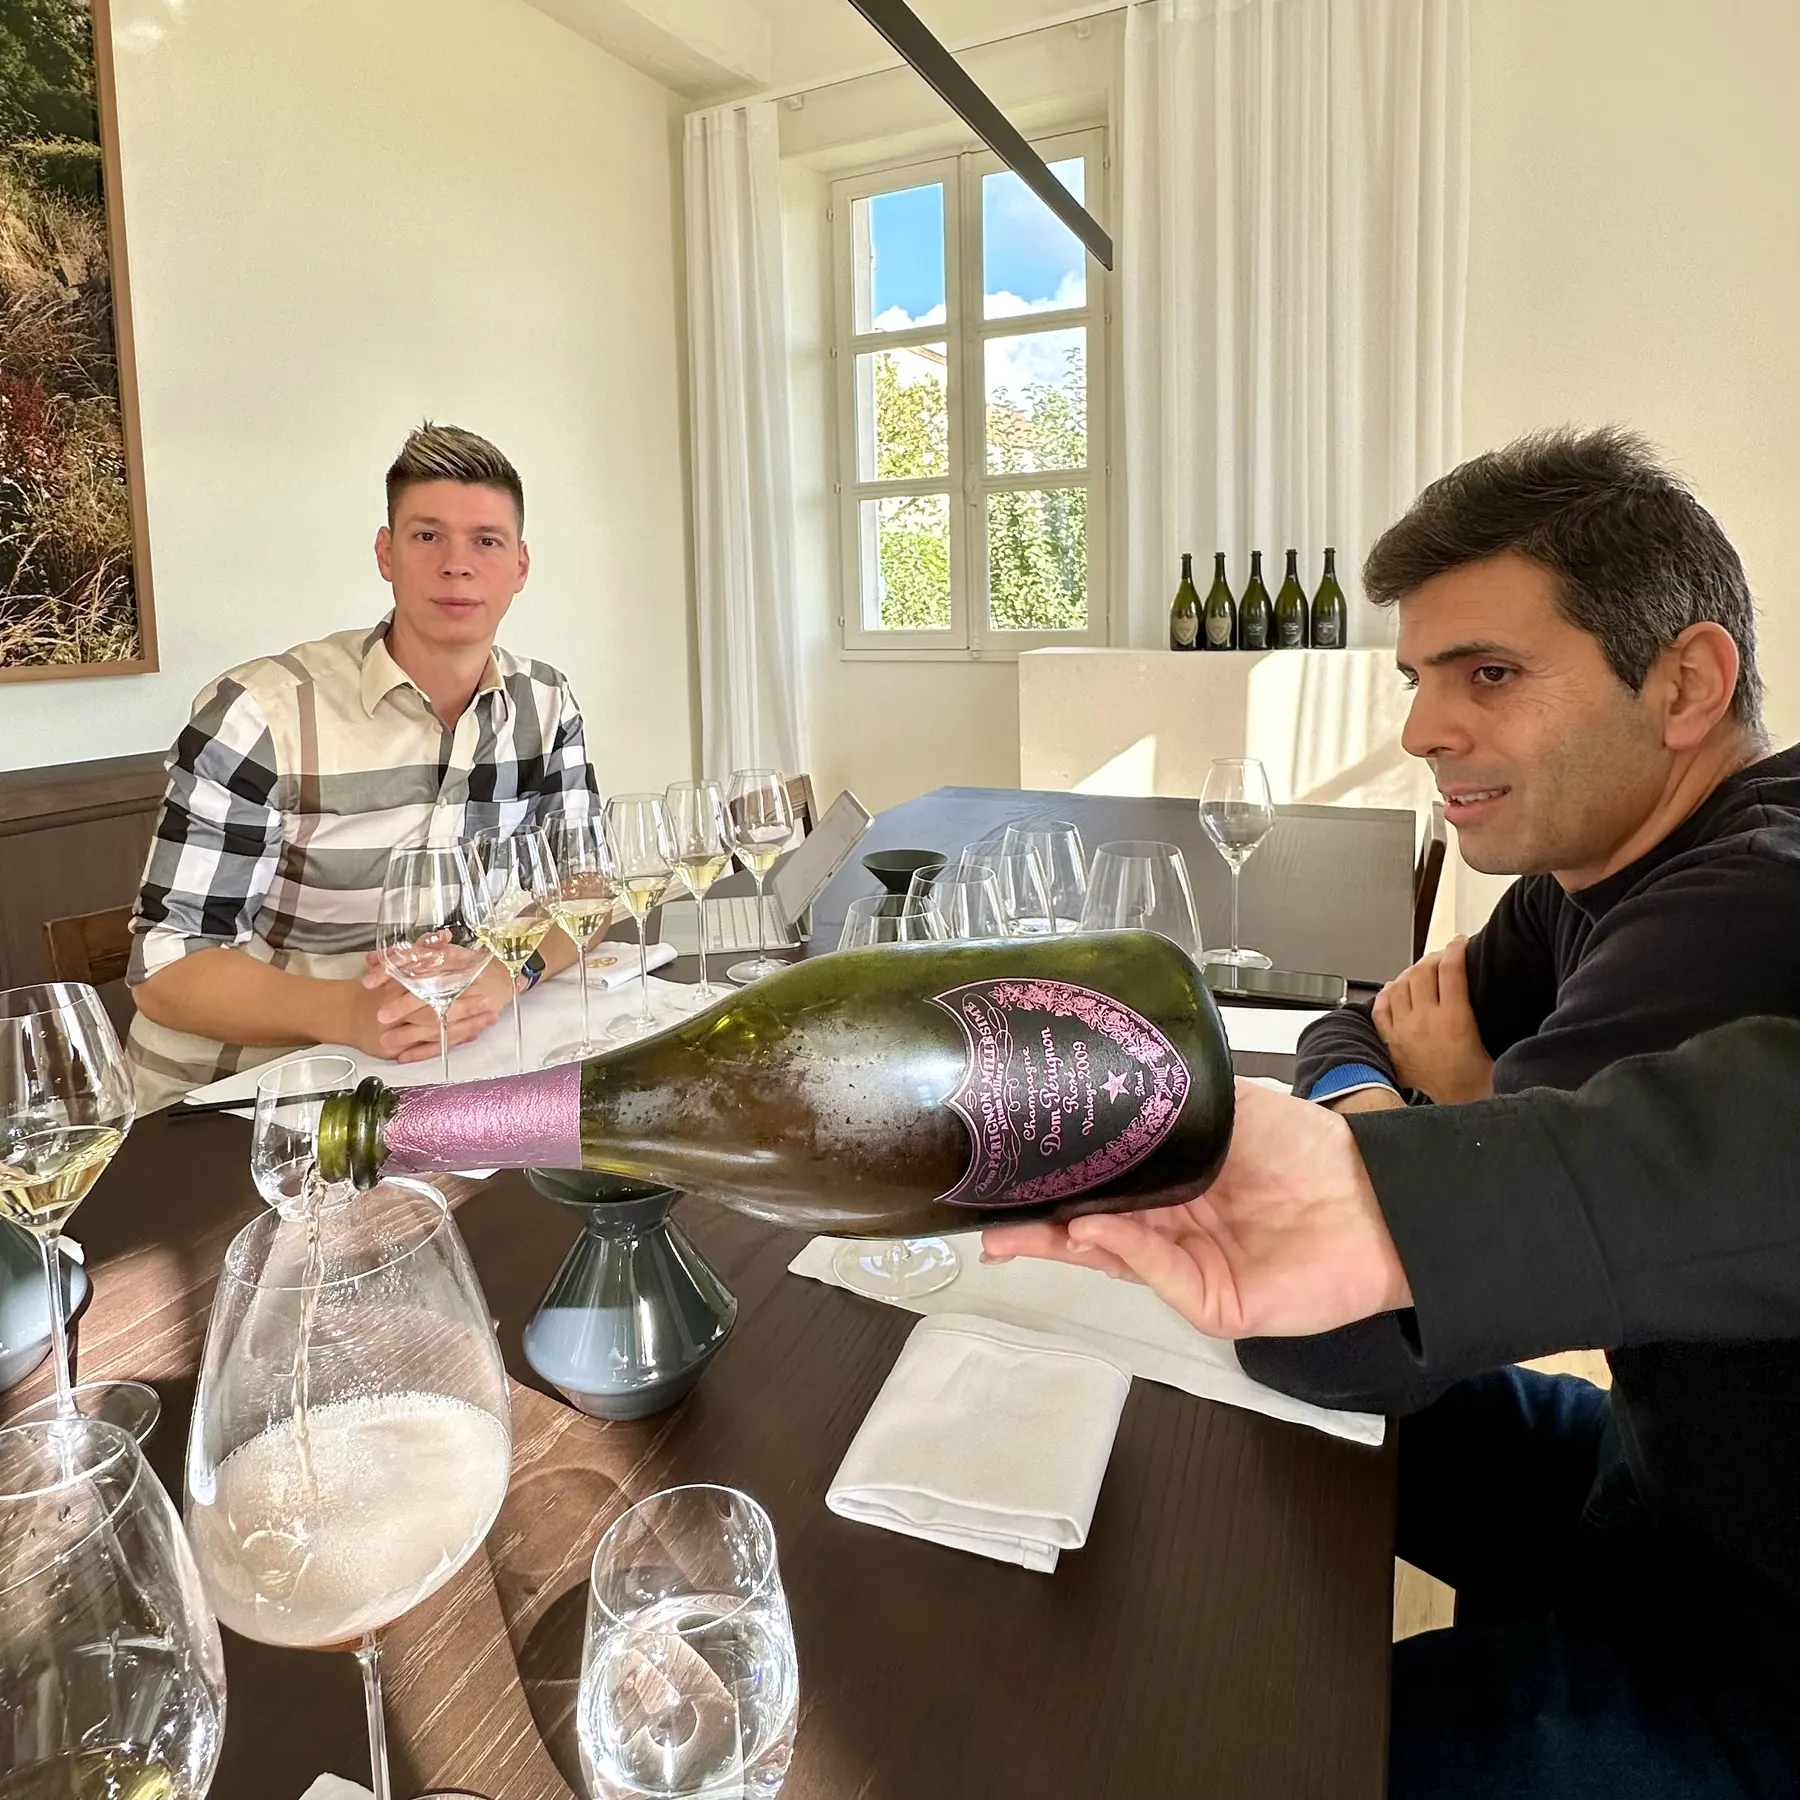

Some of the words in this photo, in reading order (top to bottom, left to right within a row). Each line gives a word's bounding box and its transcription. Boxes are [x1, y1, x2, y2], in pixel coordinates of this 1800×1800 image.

[1039, 1026, 1064, 1109] Pérignon
[1072, 1041, 1091, 1079] 2009
[1134, 1070, 1145, 1096] Brut
[1022, 1046, 1038, 1141] Champagne
[1062, 1067, 1080, 1113] Rosé
[1081, 1081, 1098, 1136] Vintage
[994, 1098, 1009, 1131] Altum
[1039, 1108, 1061, 1156] Dom
